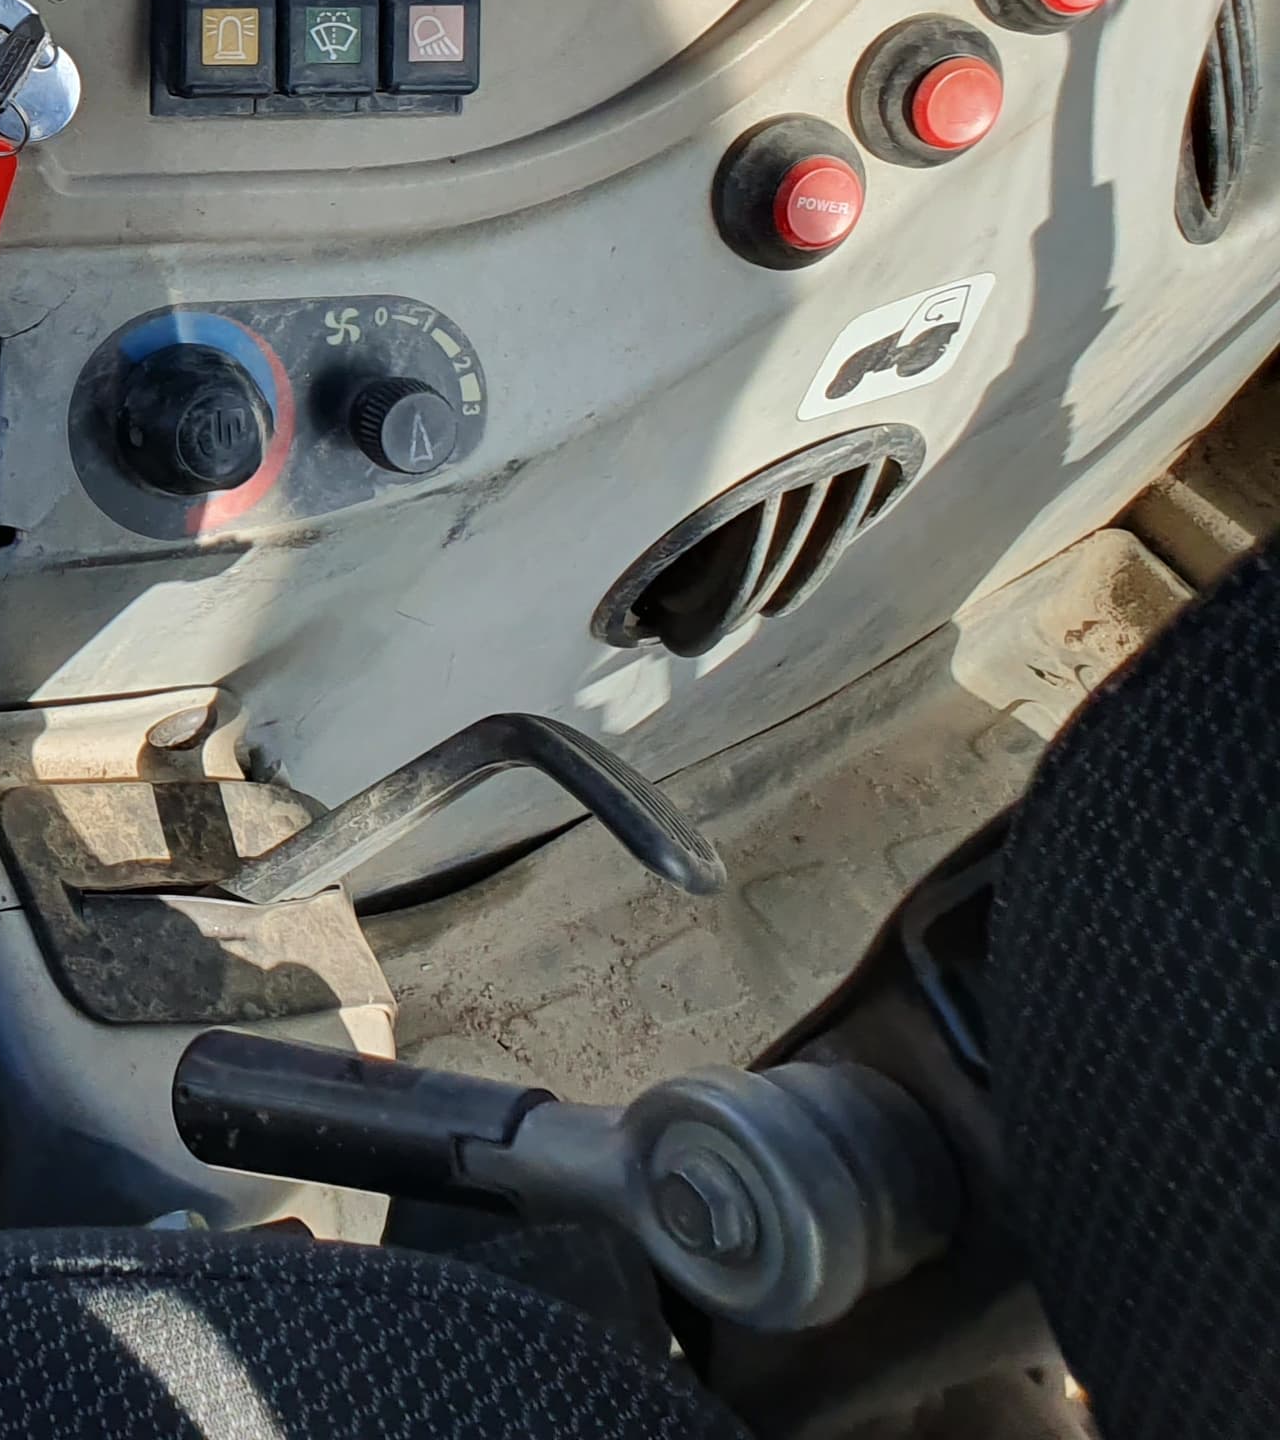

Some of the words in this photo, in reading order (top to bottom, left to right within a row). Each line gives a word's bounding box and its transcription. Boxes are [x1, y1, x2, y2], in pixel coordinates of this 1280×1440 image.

[797, 196, 849, 214] POWER
[375, 306, 388, 326] 0
[452, 355, 472, 373] 2
[462, 404, 481, 416] 3
